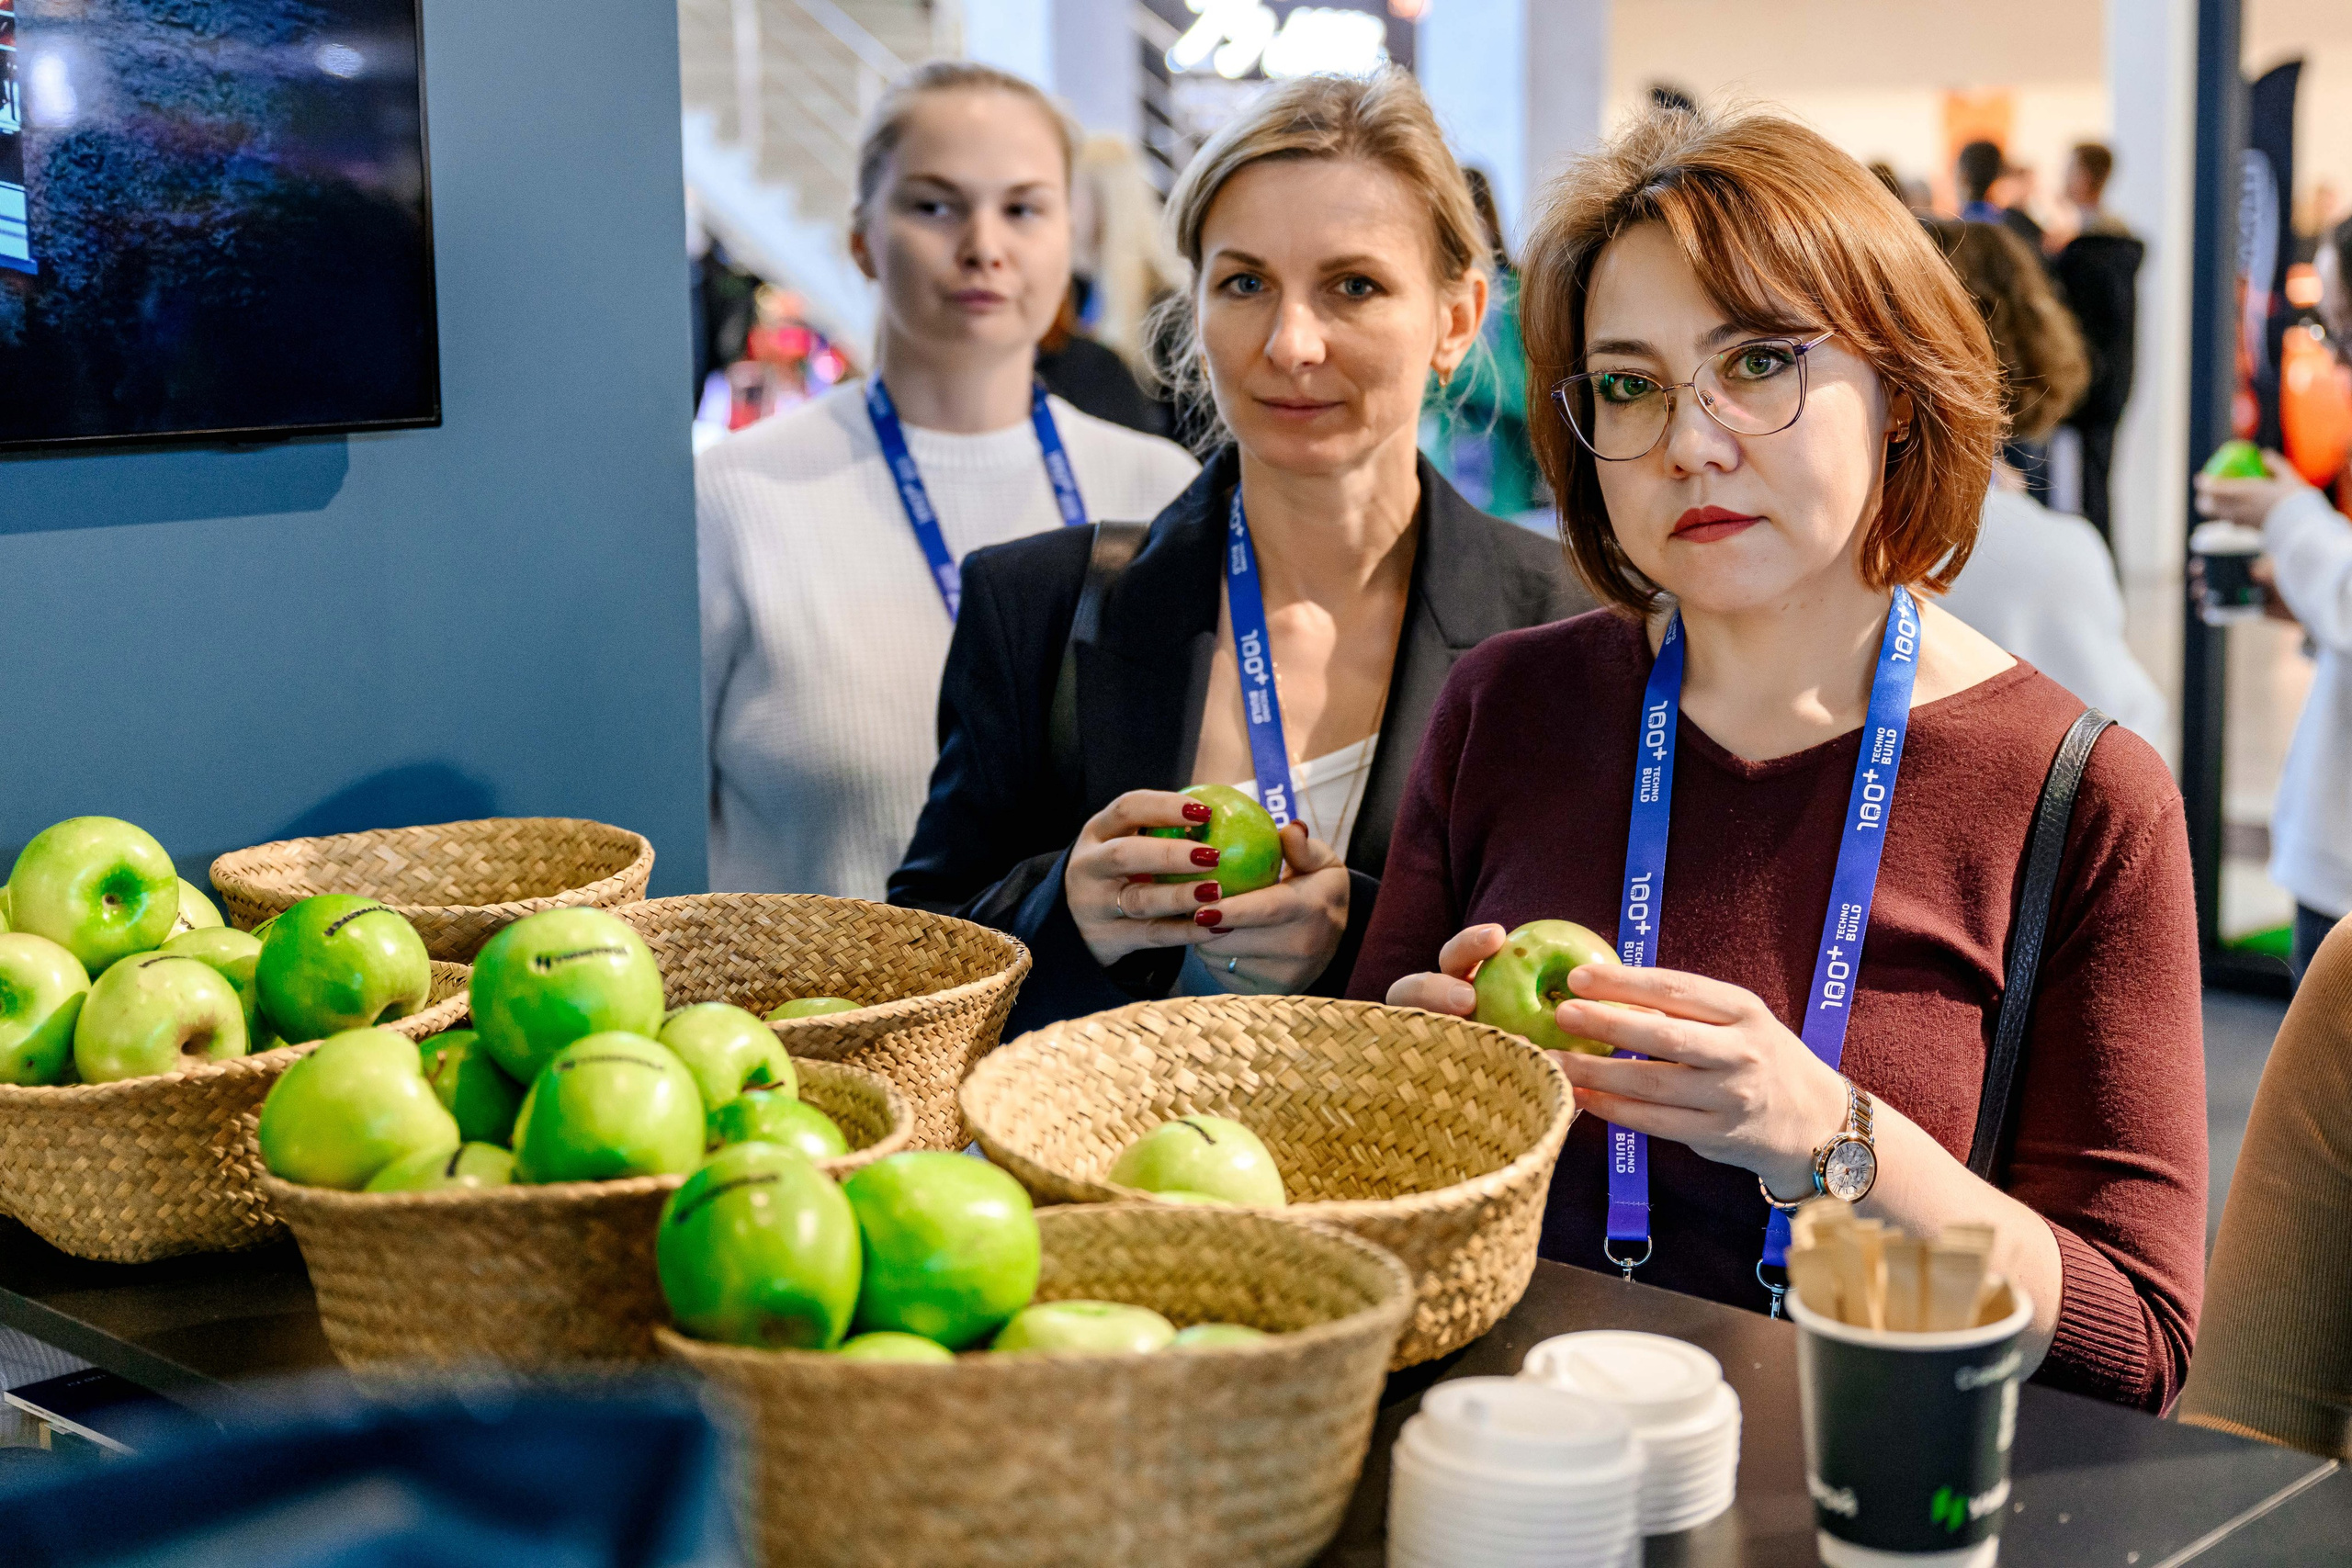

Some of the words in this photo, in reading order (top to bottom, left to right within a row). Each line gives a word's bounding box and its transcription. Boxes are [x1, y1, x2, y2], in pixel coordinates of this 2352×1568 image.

[1891, 604, 1917, 662] 100+
[1240, 628, 1270, 685] 100+
[1645, 700, 1668, 761] 100+
[1871, 727, 1885, 763] TECHNO
[1881, 728, 1897, 765] BUILD
[1640, 767, 1653, 803] BUILD
[1650, 765, 1661, 802] TECHNO
[1856, 768, 1885, 831] 100+
[1264, 783, 1291, 829] 100
[1628, 872, 1652, 935] 100+
[1836, 903, 1850, 941] TECHNO
[1845, 904, 1862, 942] BUILD
[1634, 941, 1645, 967] TECH
[1819, 945, 1849, 1010] 100+
[1615, 1133, 1626, 1174] BUILD
[1626, 1132, 1635, 1174] TECHNO
